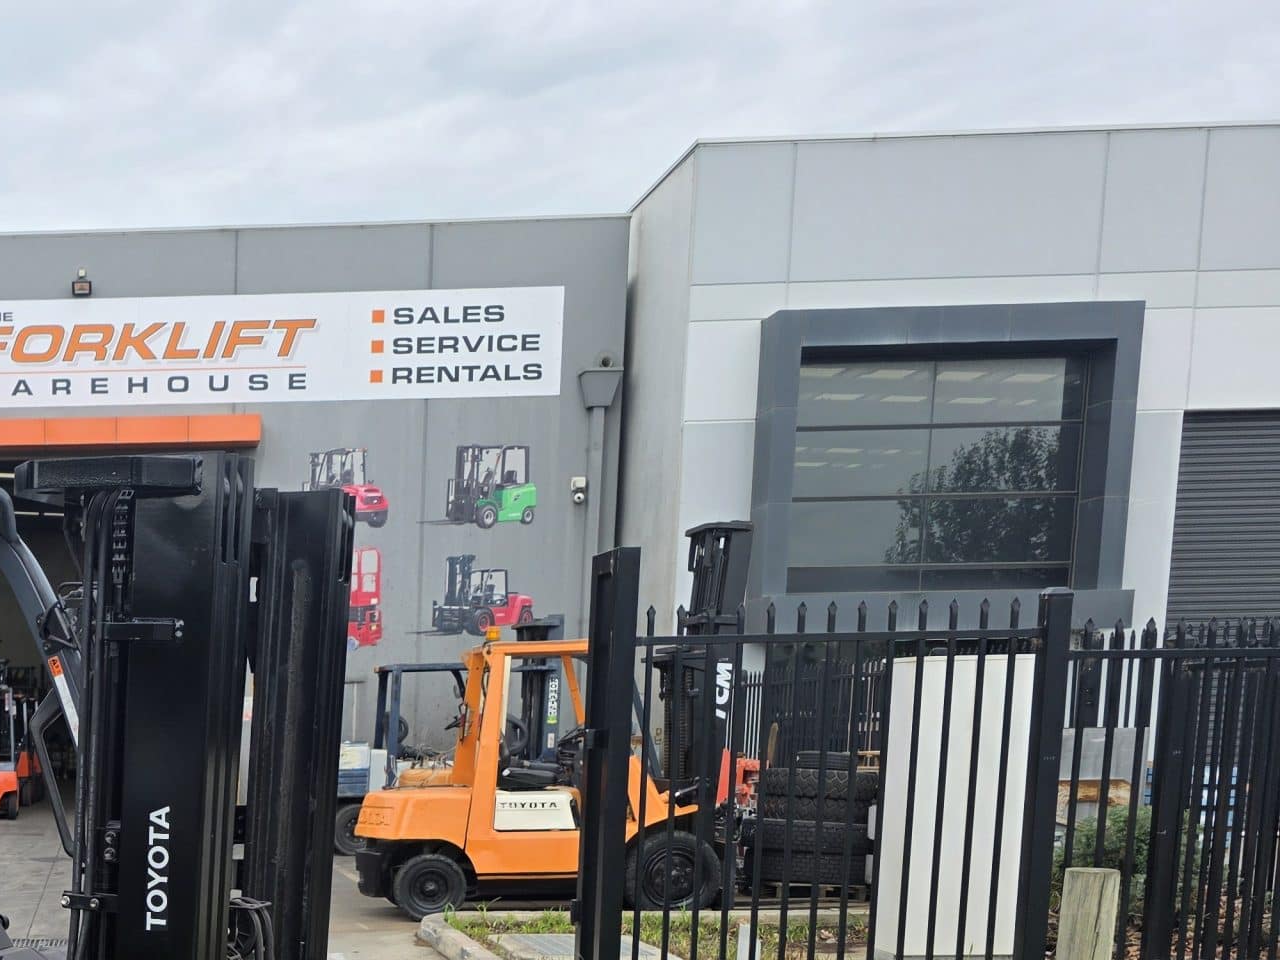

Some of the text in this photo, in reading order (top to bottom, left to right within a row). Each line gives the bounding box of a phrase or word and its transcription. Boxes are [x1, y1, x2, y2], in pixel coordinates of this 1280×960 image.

[392, 304, 505, 326] SALES
[392, 333, 542, 356] SERVICE
[391, 363, 543, 385] RENTALS
[500, 801, 558, 809] TOYOTA
[145, 805, 171, 931] TOYOTA
